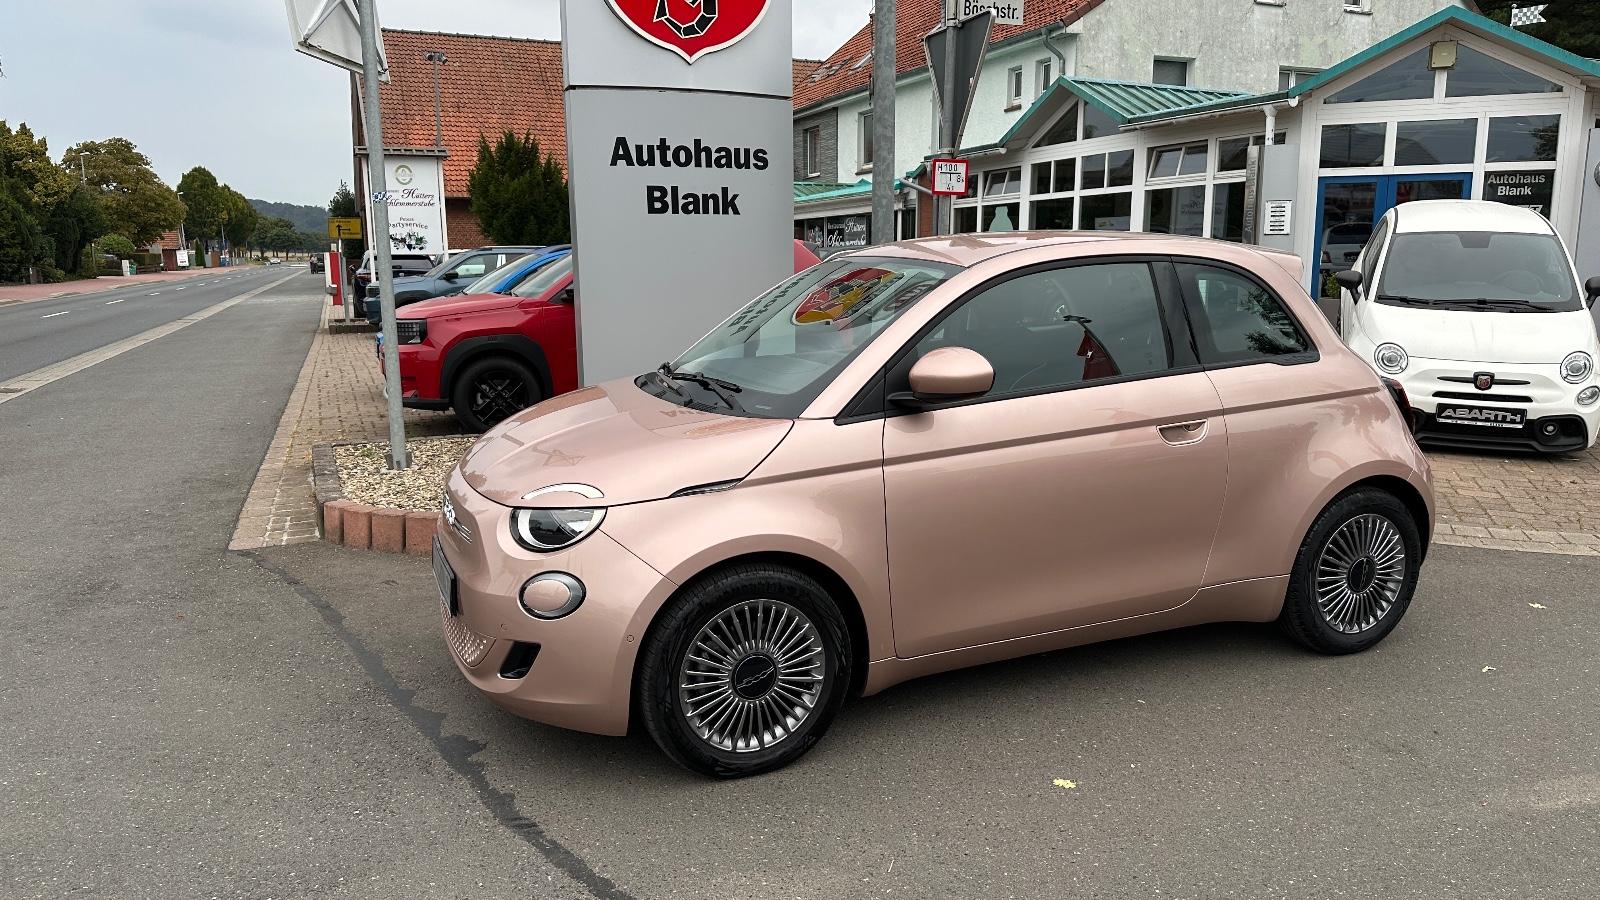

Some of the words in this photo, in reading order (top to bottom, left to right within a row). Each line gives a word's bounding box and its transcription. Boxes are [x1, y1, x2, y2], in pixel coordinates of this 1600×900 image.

[964, 0, 1019, 19] Böhstr.
[610, 136, 769, 170] Autohaus
[1487, 173, 1546, 184] Autohaus
[646, 185, 741, 215] Blank
[1497, 185, 1532, 196] Blank
[1245, 190, 1255, 233] Autohus
[1441, 408, 1521, 422] ABARTH
